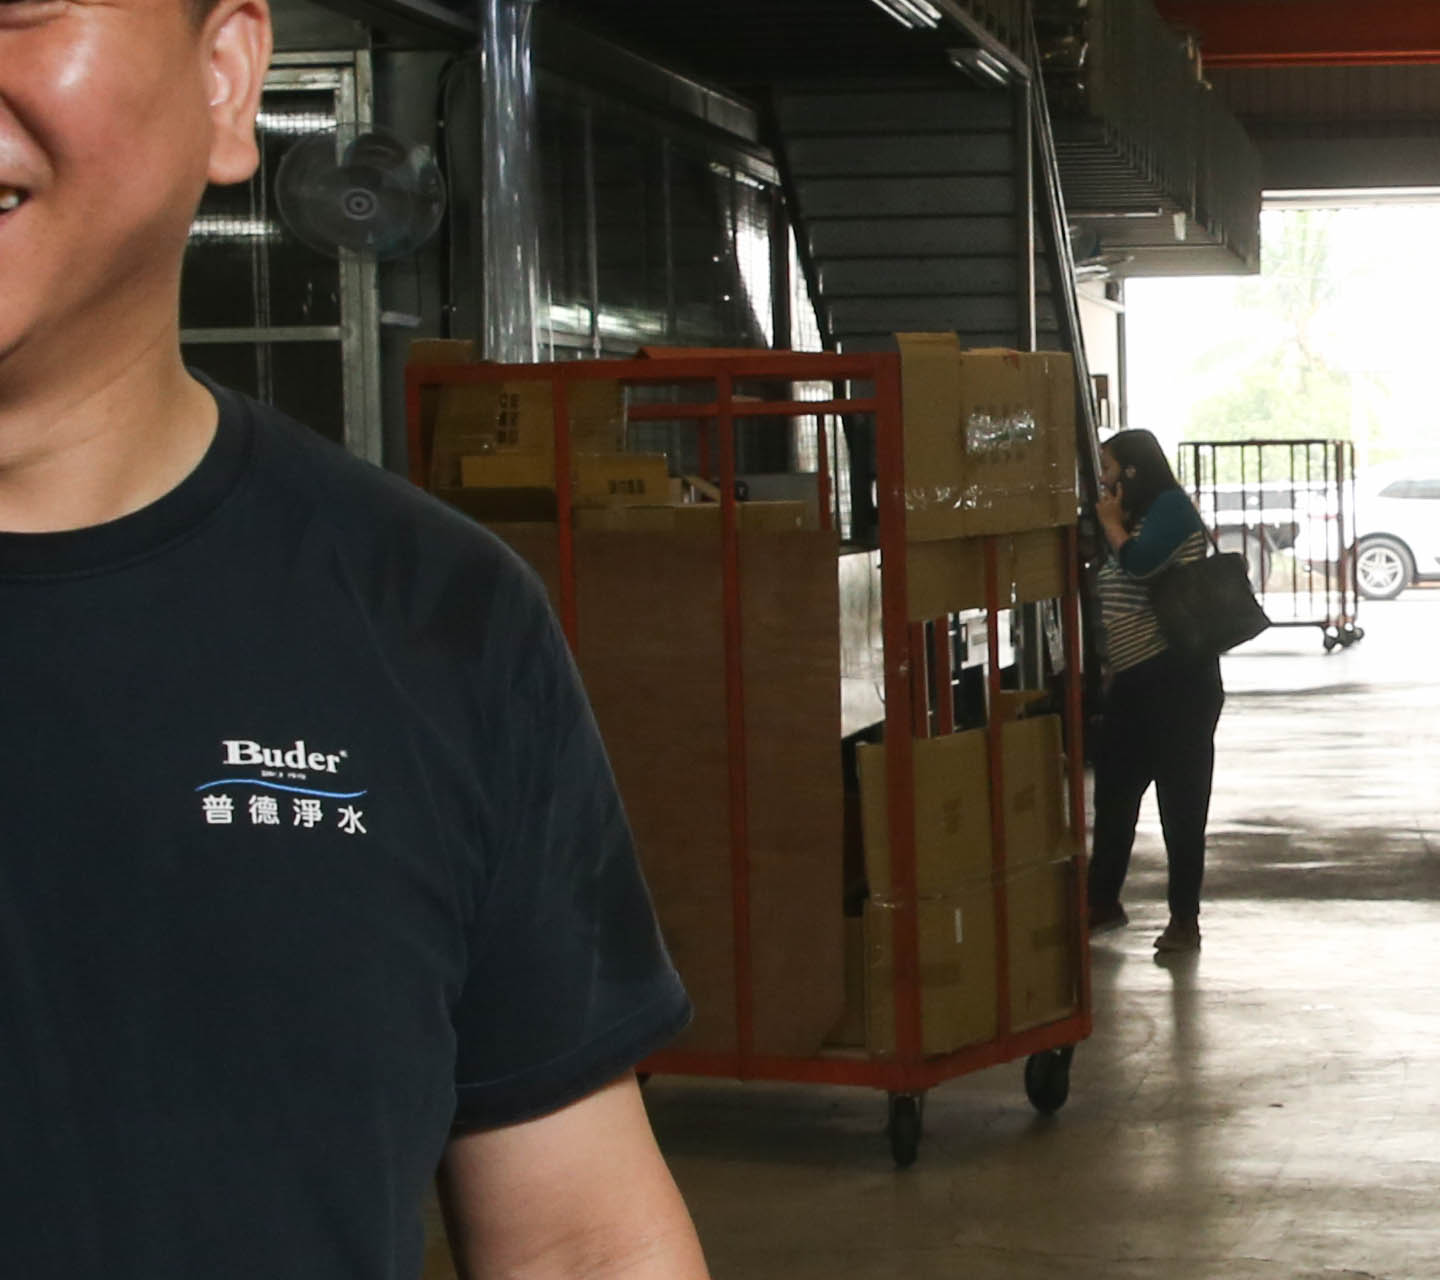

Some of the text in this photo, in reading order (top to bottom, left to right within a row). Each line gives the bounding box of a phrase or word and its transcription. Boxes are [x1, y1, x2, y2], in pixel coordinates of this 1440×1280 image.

[222, 740, 341, 773] Buder
[202, 794, 367, 835] 普德淨水
